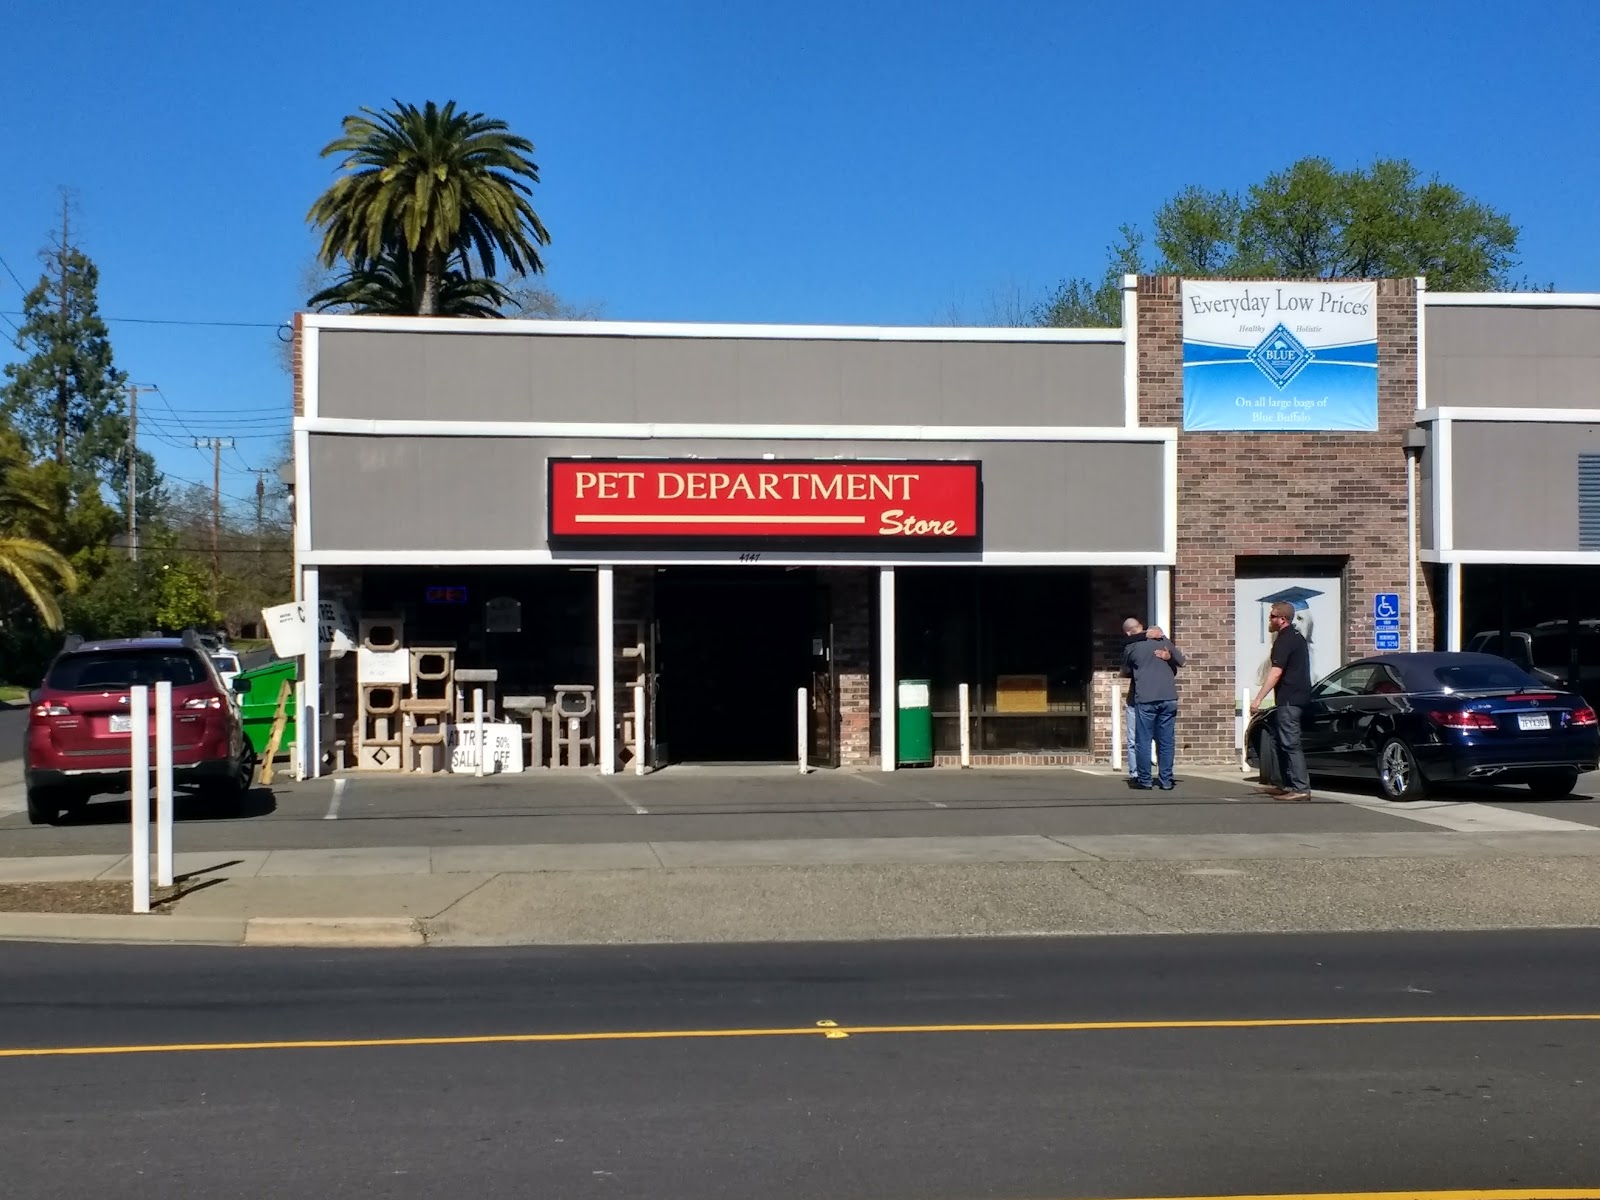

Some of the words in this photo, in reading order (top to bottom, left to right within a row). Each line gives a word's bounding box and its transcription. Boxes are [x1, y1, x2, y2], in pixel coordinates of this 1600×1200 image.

[1189, 289, 1271, 318] Everyday
[1275, 288, 1314, 312] Low
[1318, 291, 1369, 316] Prices
[1238, 325, 1266, 334] Healthy
[1296, 325, 1322, 333] Holistic
[1266, 350, 1296, 360] BLUE
[1235, 396, 1252, 407] On
[1254, 396, 1266, 407] all
[1268, 396, 1292, 410] large
[1293, 396, 1315, 410] bags
[1316, 396, 1329, 407] of
[1252, 411, 1274, 422] Blue
[1276, 411, 1311, 422] Buffalo
[576, 472, 645, 499] PET
[657, 472, 920, 501] DEPARTMENT
[879, 509, 957, 535] Store
[495, 736, 510, 748] 50%
[493, 750, 510, 763] OFF
